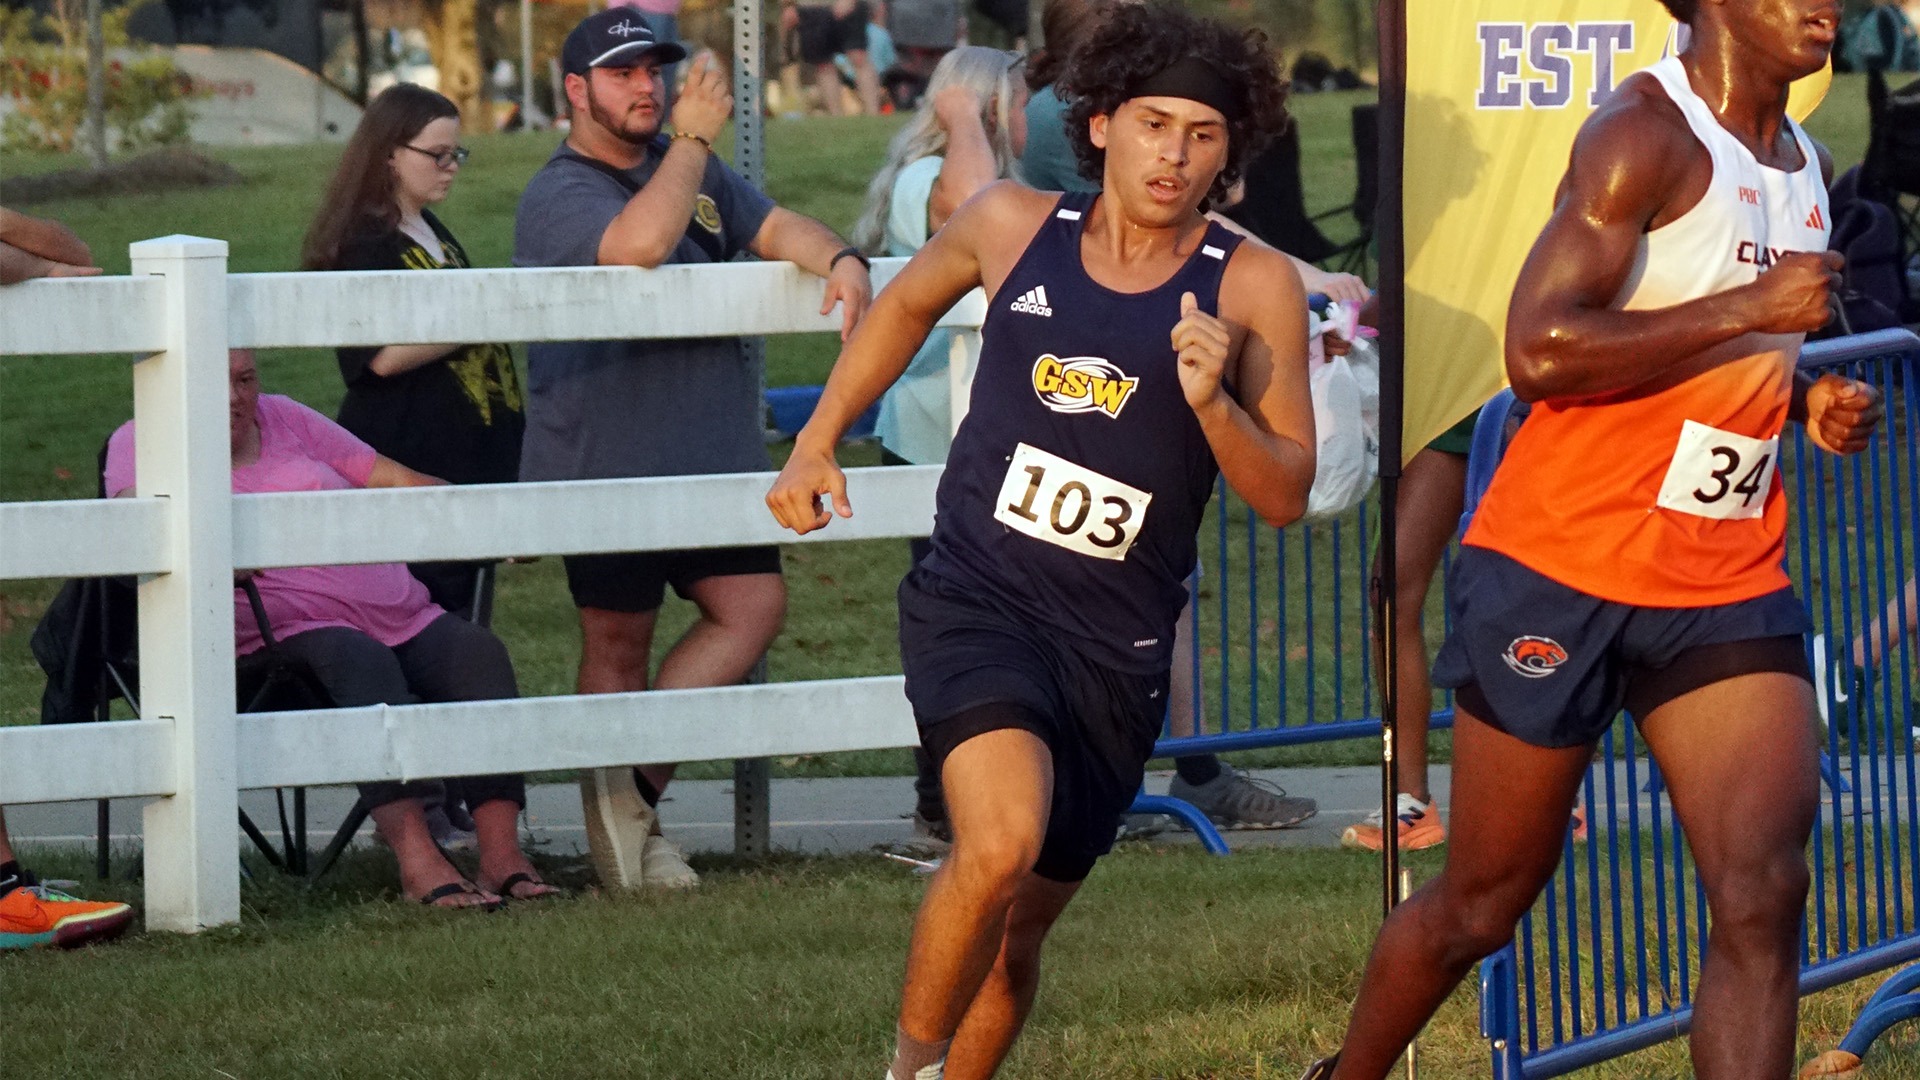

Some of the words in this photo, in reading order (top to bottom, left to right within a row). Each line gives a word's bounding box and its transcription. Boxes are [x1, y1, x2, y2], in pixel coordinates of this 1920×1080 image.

[1476, 21, 1634, 108] EST
[1010, 301, 1053, 317] adidas
[1033, 355, 1137, 416] GSW
[1008, 465, 1132, 548] 103
[1693, 446, 1771, 507] 34
